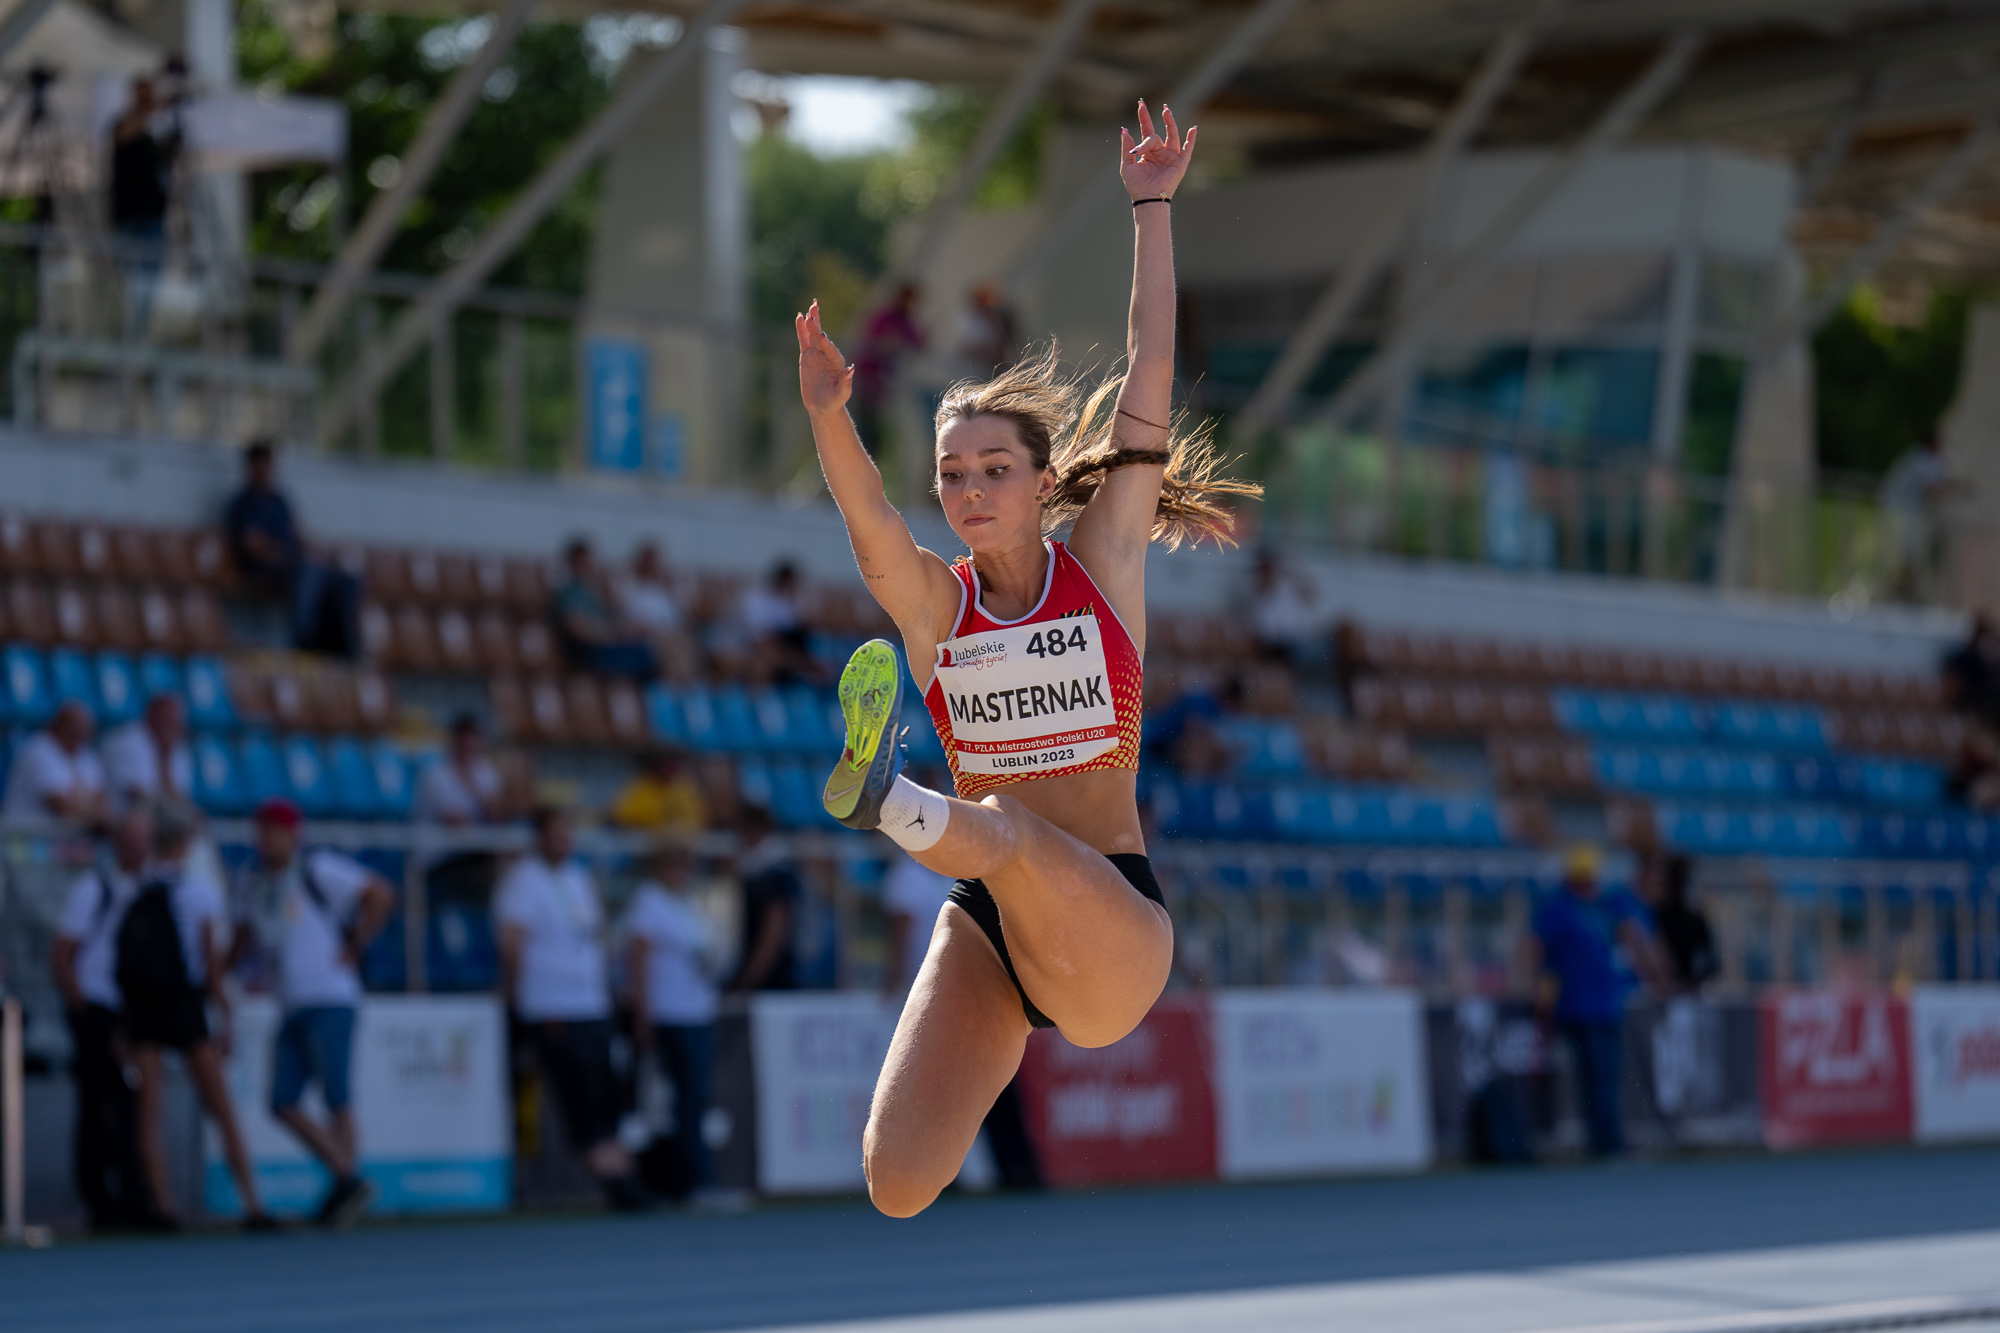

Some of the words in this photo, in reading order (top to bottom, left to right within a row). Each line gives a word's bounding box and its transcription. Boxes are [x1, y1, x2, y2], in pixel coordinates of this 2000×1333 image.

[955, 641, 1005, 661] lubelskie
[1026, 625, 1087, 659] 484
[986, 653, 1008, 667] życie!
[949, 675, 1107, 724] MASTERNAK
[962, 742, 974, 752] 77.
[975, 744, 996, 753] PZLA
[996, 738, 1055, 752] Mistrzostwa
[1056, 732, 1085, 745] Polski
[1087, 728, 1106, 740] U20
[992, 755, 1039, 768] LUBLIN
[1041, 749, 1075, 764] 2023
